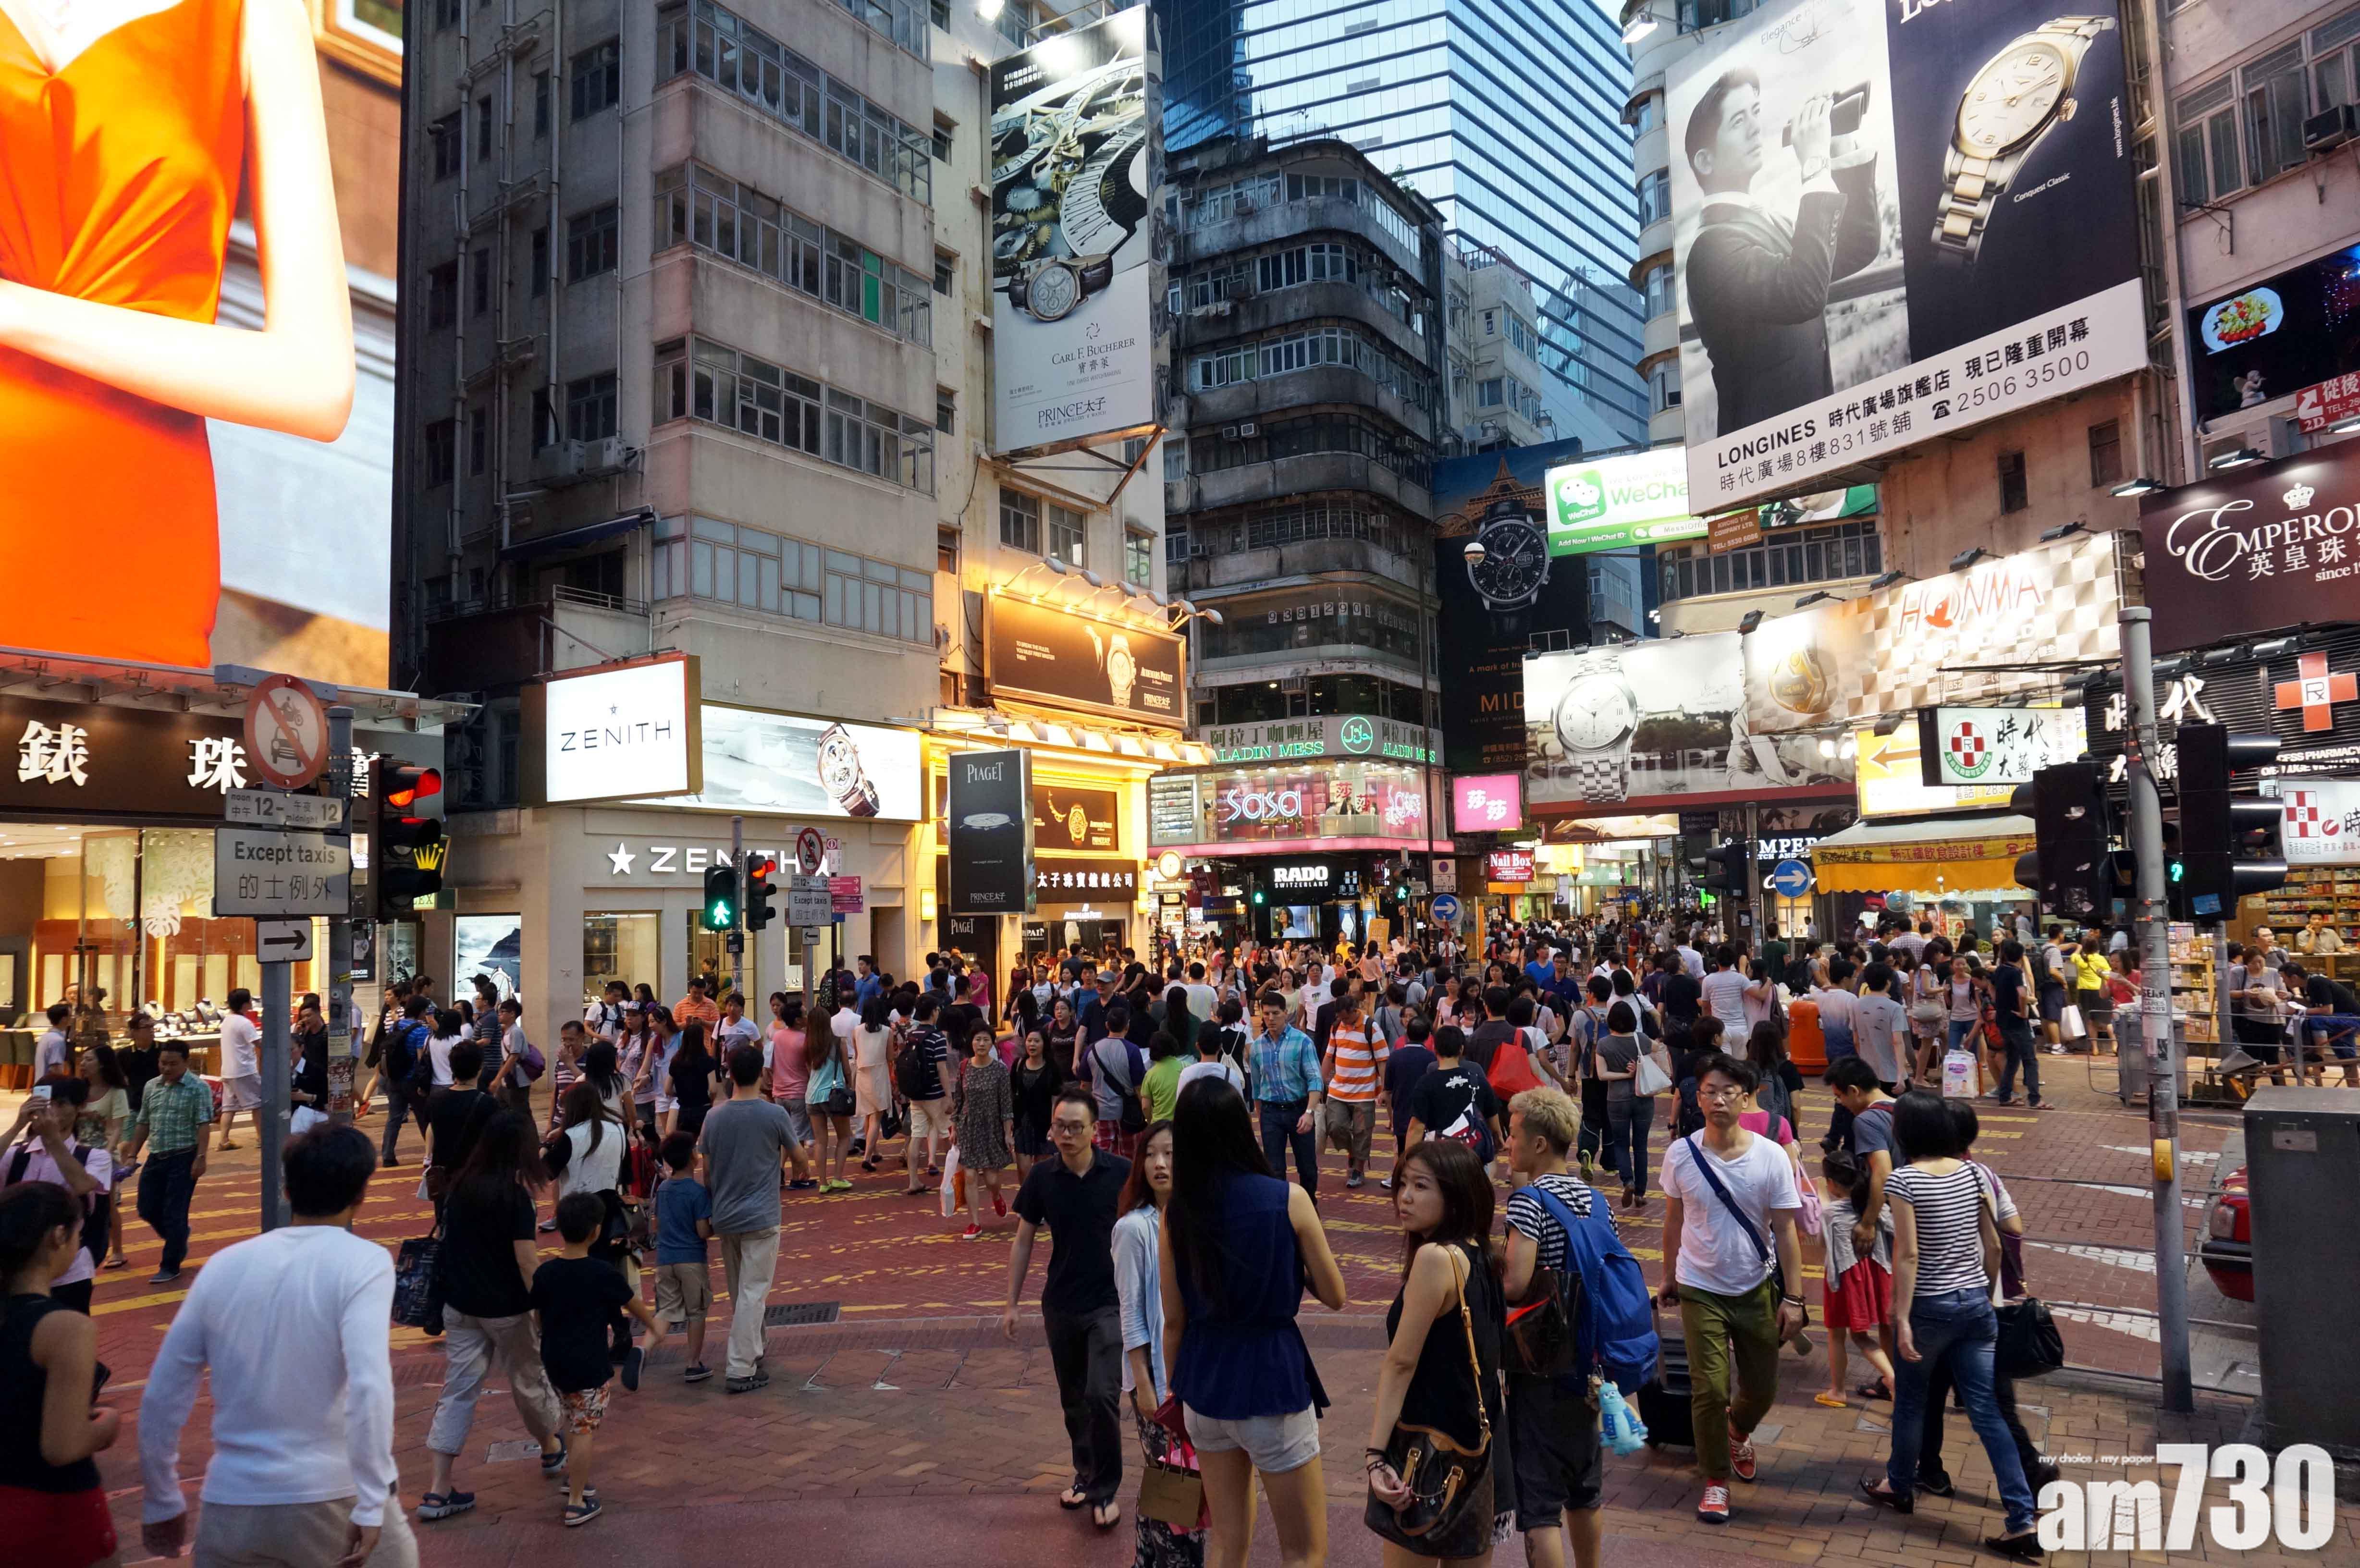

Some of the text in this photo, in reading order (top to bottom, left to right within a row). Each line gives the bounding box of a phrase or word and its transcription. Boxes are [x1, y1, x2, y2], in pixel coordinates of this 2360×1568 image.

[2014, 172, 2072, 203] Conquest Classic
[1087, 338, 1135, 357] BUCHERER
[1718, 316, 2090, 468] LONGINES 時代廣場旗艦店 現已隆重開幕
[1957, 376, 2017, 413] 2506
[2025, 351, 2090, 388] 3500
[1567, 506, 1600, 520] WeChat
[1558, 538, 1572, 547] Add
[1572, 538, 1587, 546] Now
[1591, 534, 1616, 543] WeChat
[1714, 525, 1741, 537] COMPANY
[2166, 500, 2360, 581] EMPERO
[2315, 565, 2351, 582] since
[561, 720, 671, 752] ZENITH
[1996, 713, 2049, 750] 時代
[1279, 741, 1325, 759] MESS
[1382, 742, 1436, 764] ALADIN MES
[967, 761, 1004, 783] PIAGET
[231, 794, 251, 802] noon
[255, 797, 273, 816] 12
[232, 805, 252, 818] 中午
[321, 803, 338, 821] 12
[1467, 789, 1507, 821] 莎莎
[234, 841, 335, 865] Except taxis
[1490, 853, 1532, 867] Nail Box
[1273, 866, 1328, 883] RADO
[238, 873, 332, 901] 的士例外
[794, 896, 827, 905] Except taxis
[950, 918, 975, 935] PIAGET
